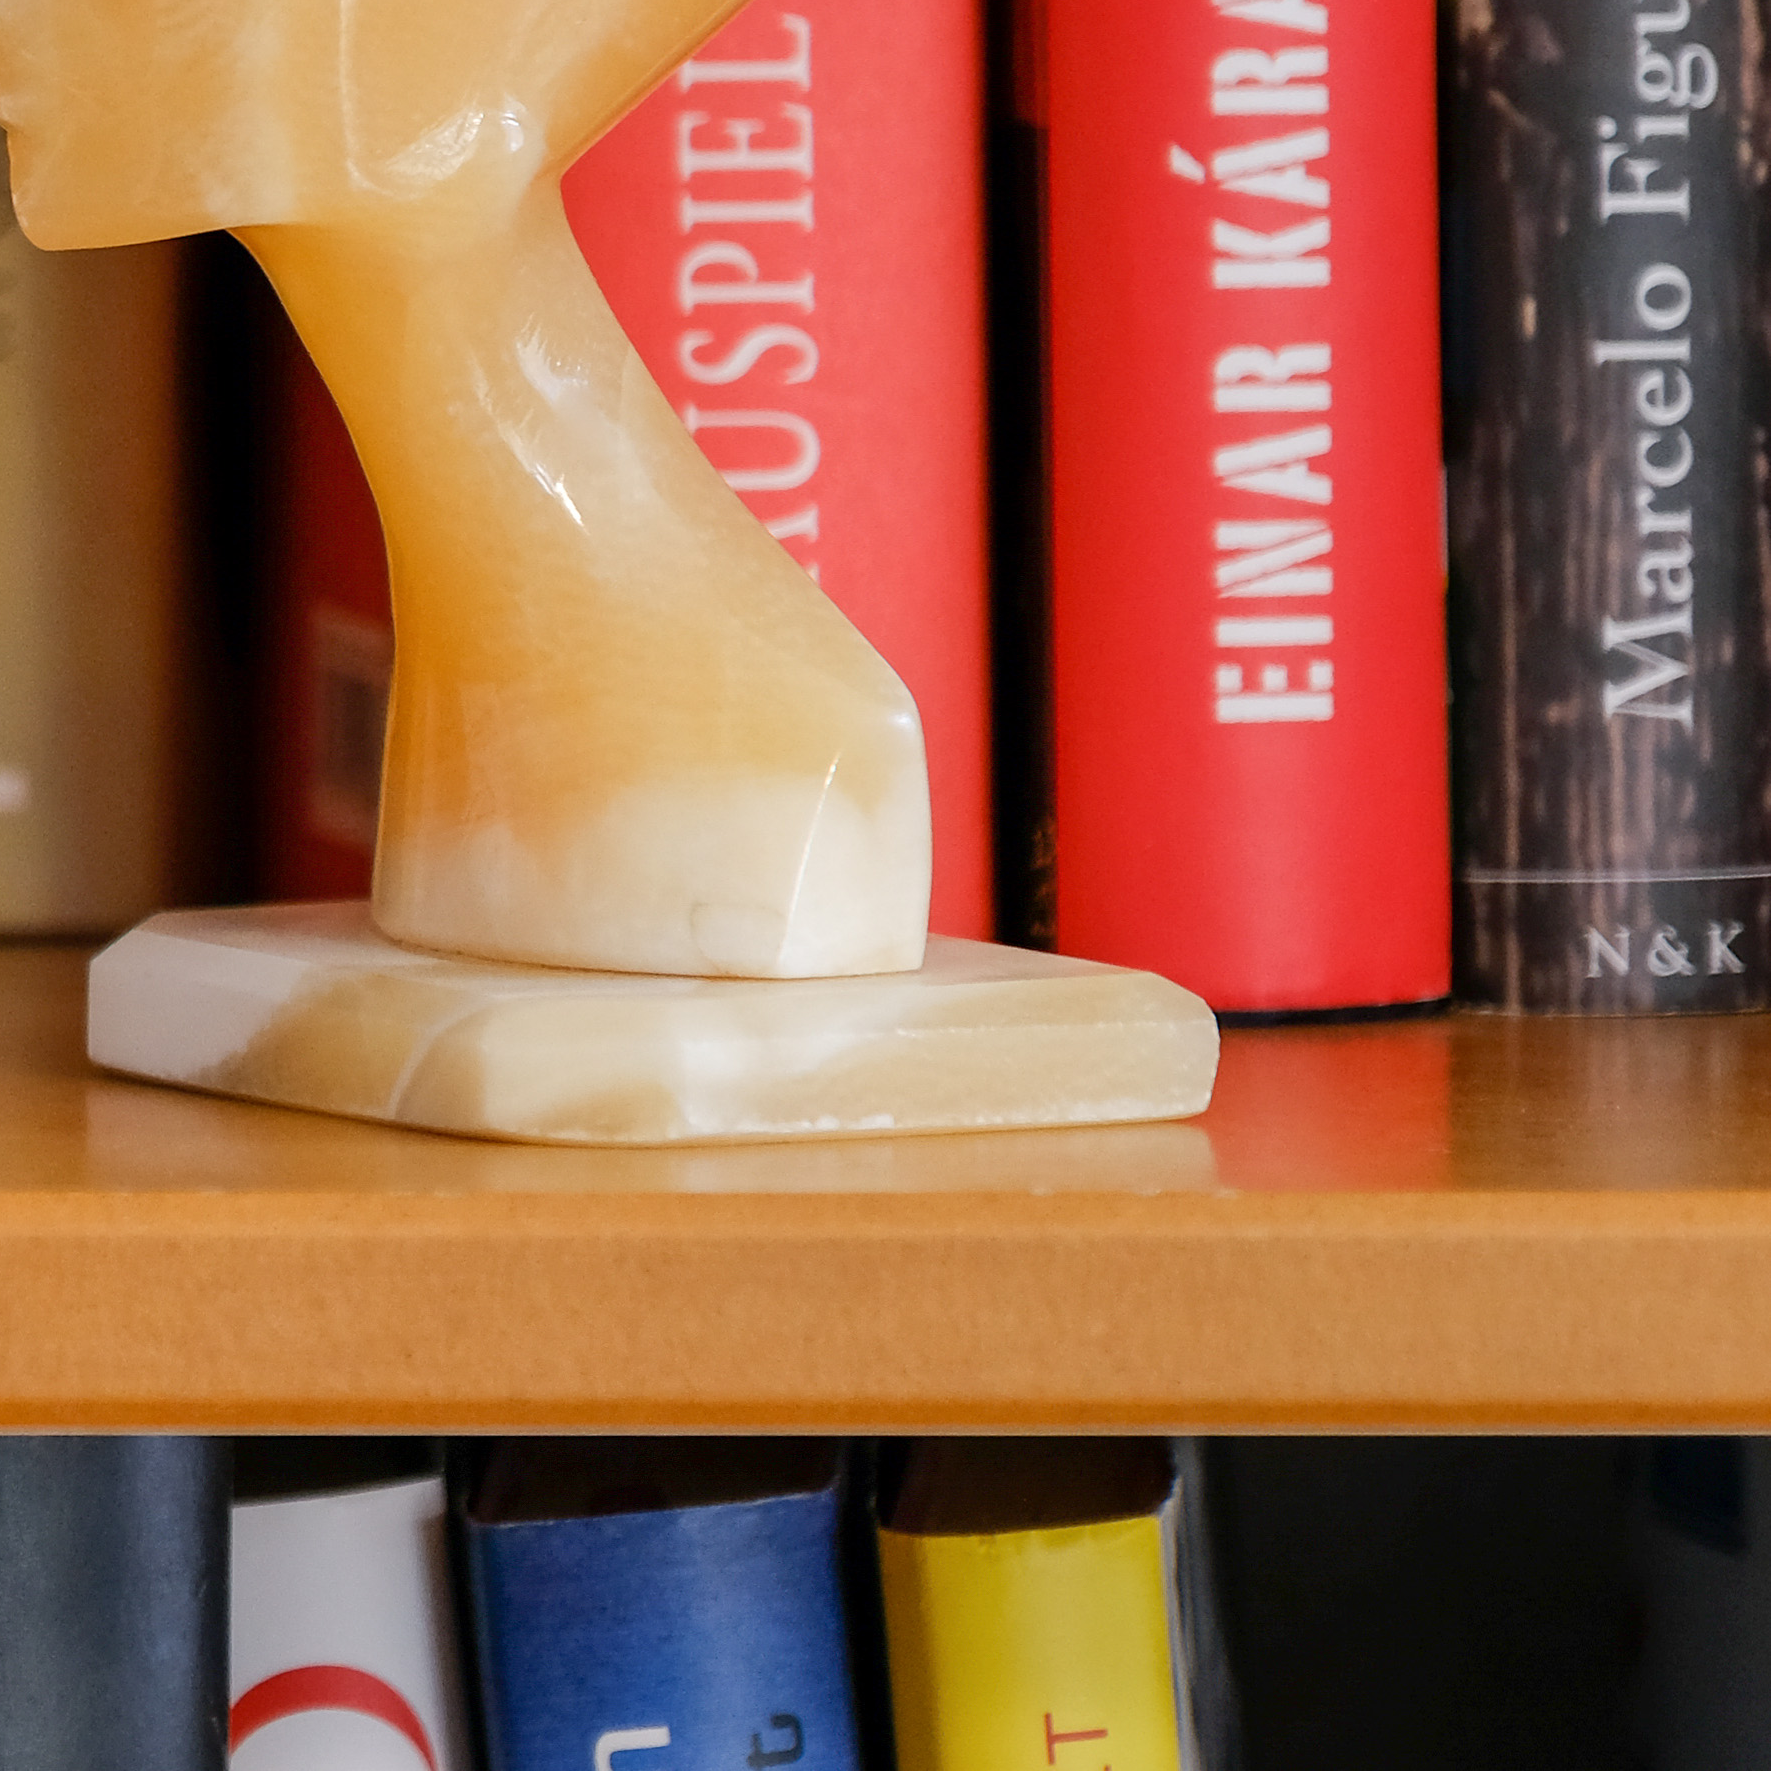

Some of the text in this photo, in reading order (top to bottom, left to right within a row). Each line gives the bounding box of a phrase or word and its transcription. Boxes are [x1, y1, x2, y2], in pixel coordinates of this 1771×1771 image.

[1213, 341, 1334, 727] EINAR
[1596, 260, 1695, 730] Marcelo
[1583, 920, 1747, 979] N & K
